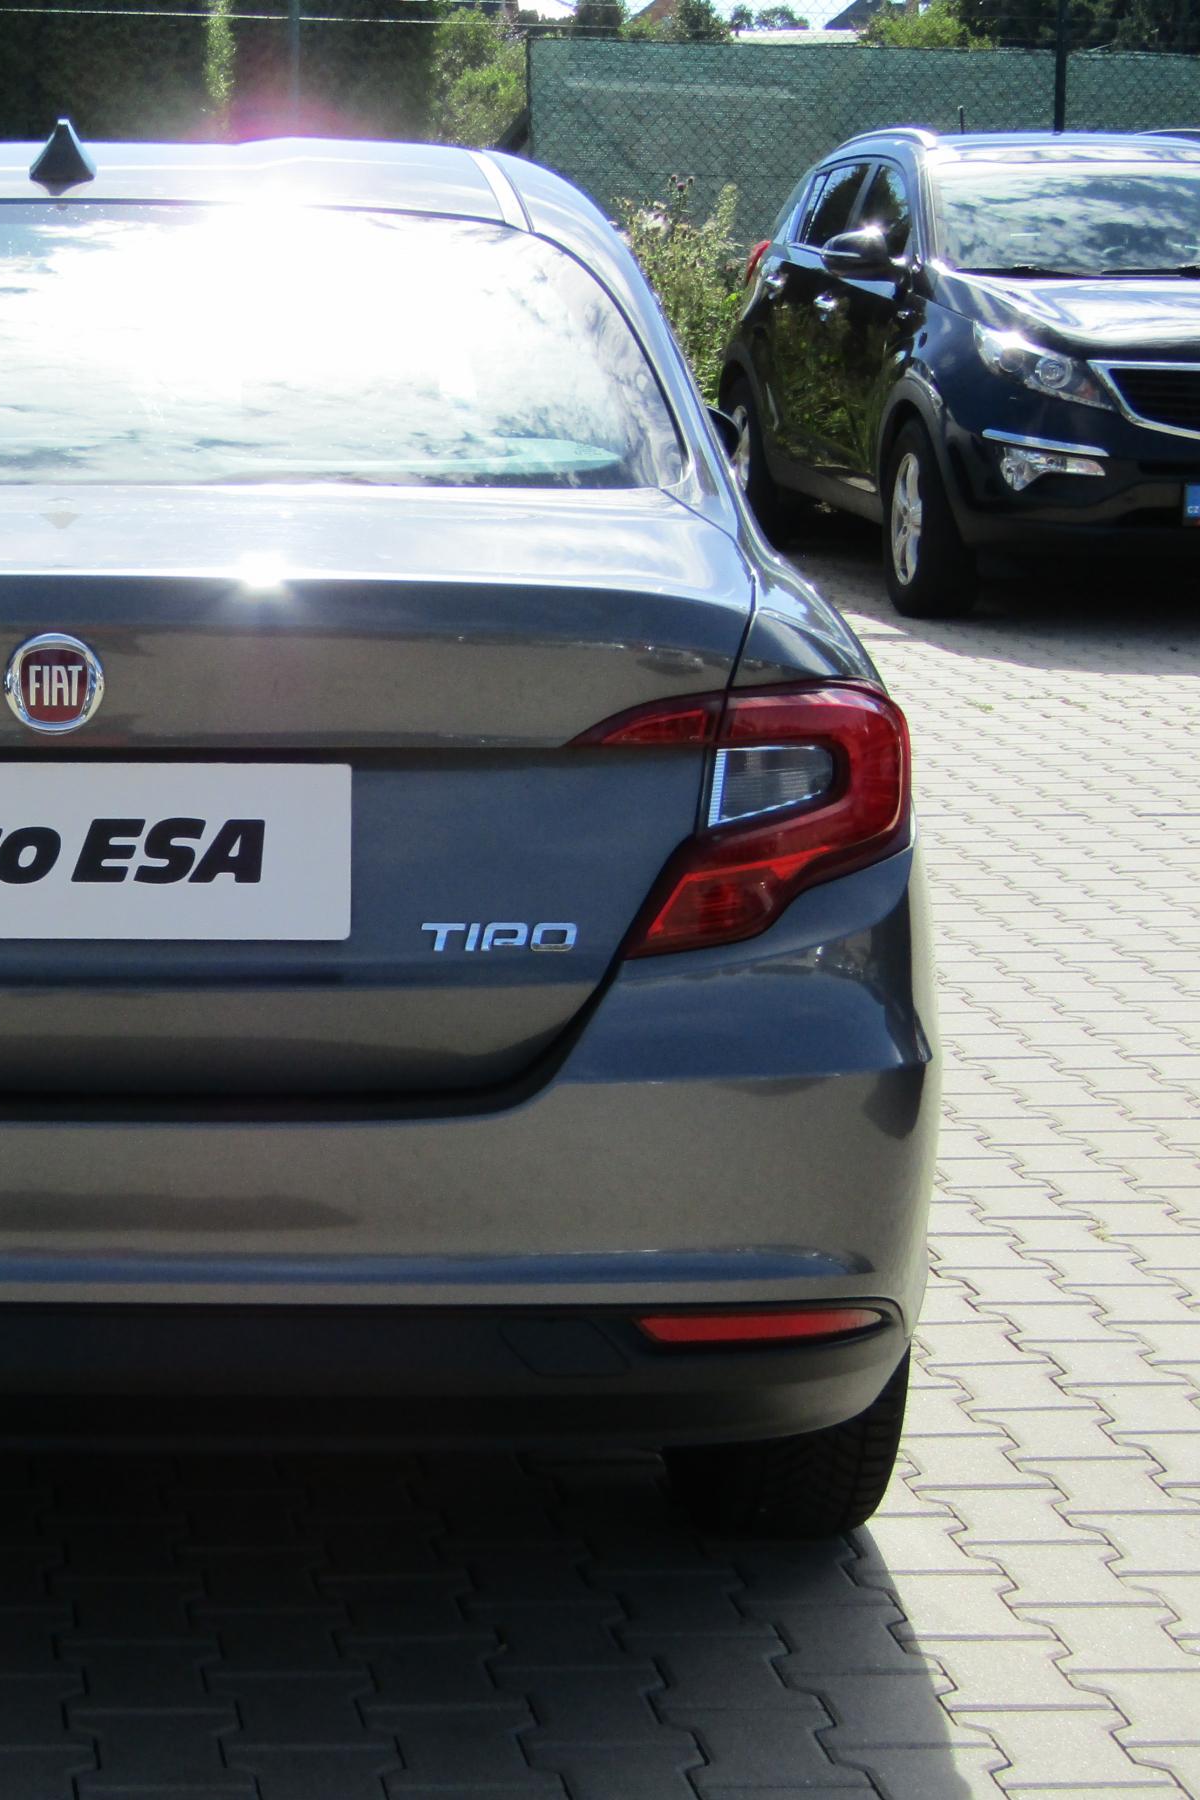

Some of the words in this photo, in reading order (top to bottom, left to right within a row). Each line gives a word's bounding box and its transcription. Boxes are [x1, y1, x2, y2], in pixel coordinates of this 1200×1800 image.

[28, 665, 83, 706] FIAT
[70, 816, 266, 884] ESA
[421, 922, 578, 952] TIPO
